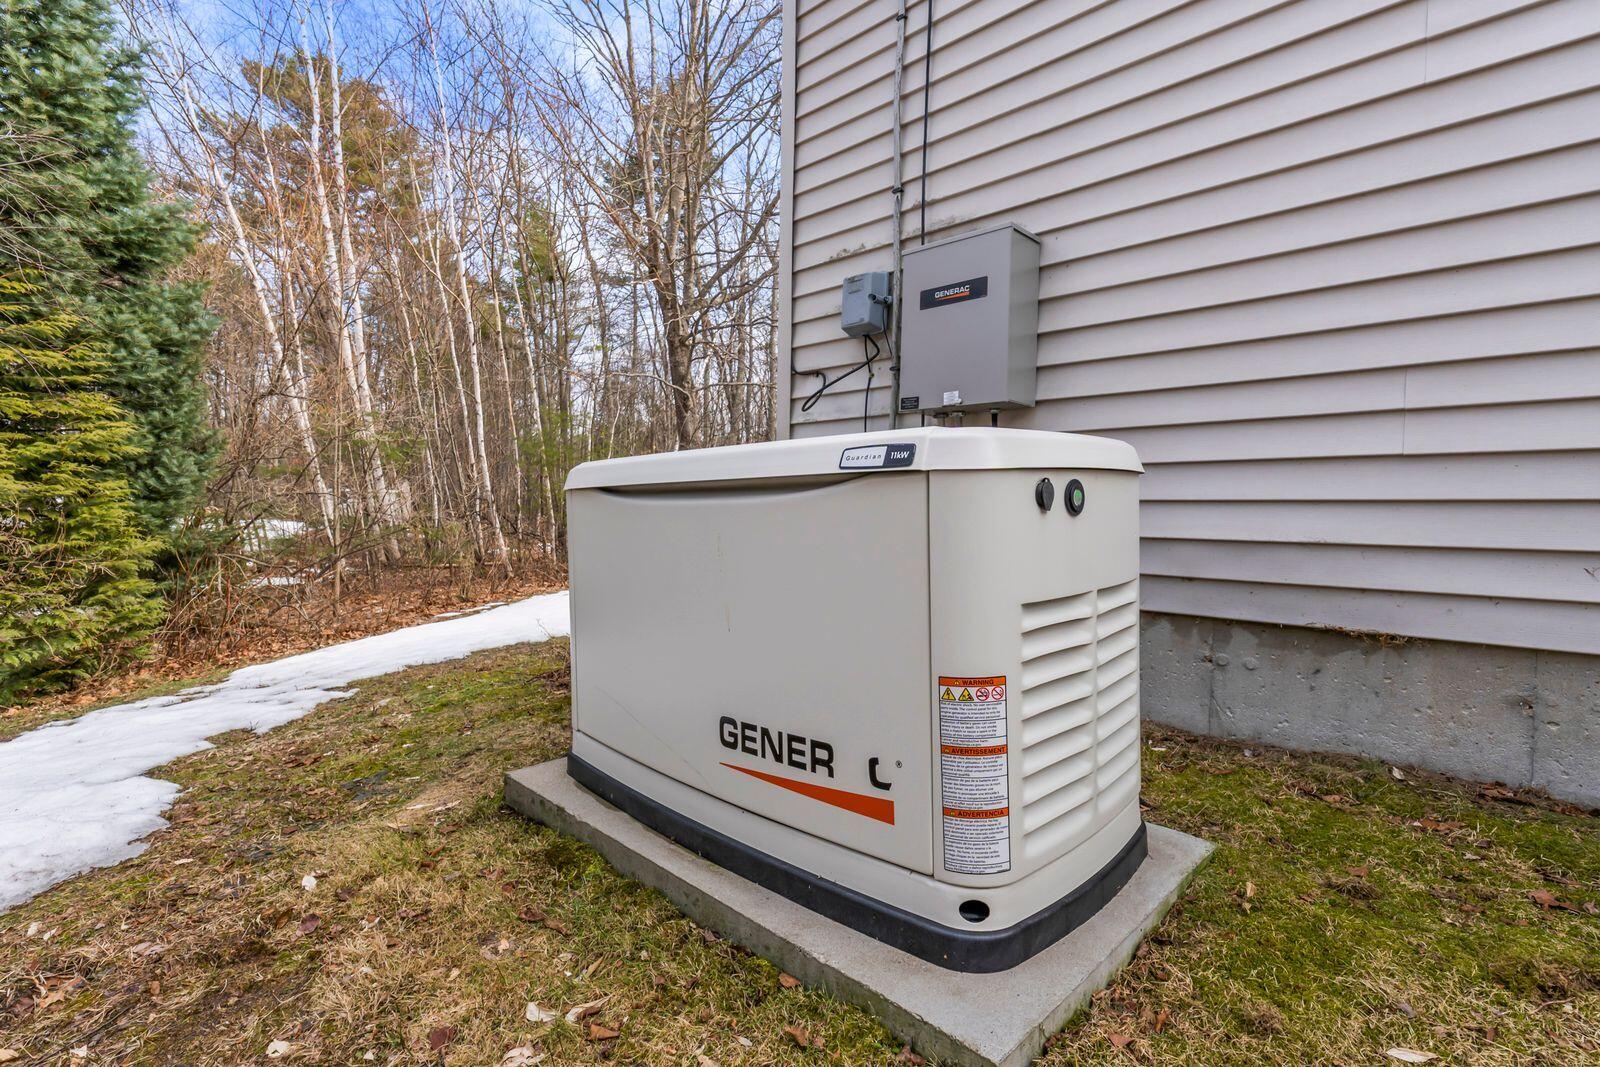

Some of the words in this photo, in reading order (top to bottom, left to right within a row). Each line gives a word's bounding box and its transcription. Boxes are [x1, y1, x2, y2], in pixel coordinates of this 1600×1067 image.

[934, 285, 970, 298] GENERAC
[890, 451, 910, 459] 11kW
[719, 716, 892, 791] GENERC
